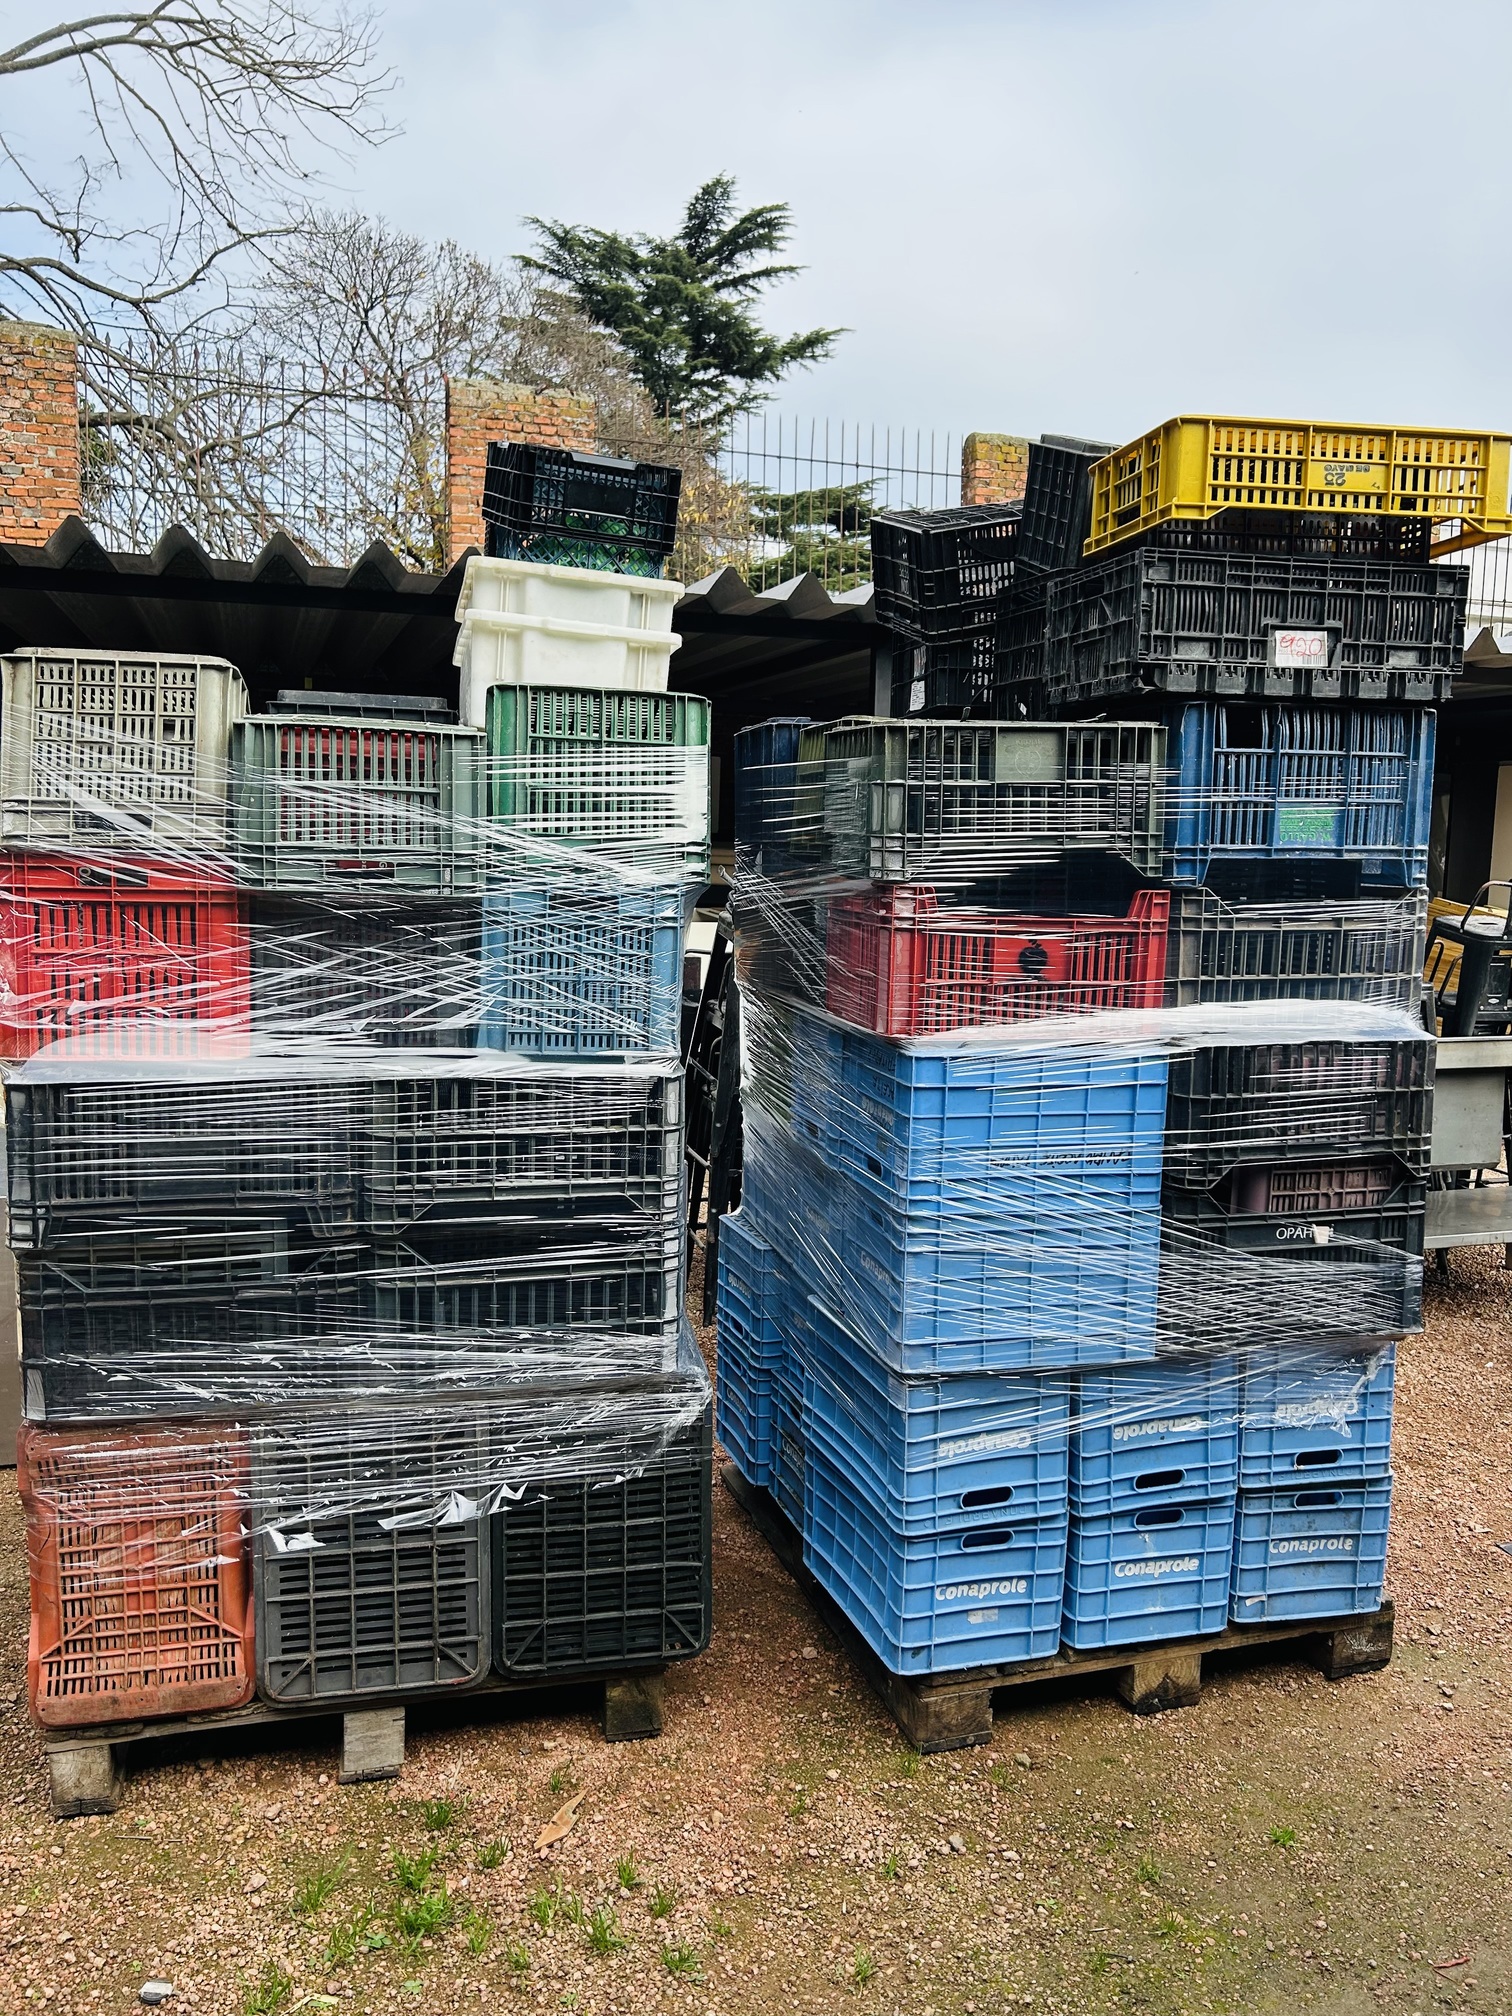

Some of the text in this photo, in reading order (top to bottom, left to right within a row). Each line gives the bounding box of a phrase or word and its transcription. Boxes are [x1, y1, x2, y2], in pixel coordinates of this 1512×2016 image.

[1324, 472, 1346, 487] 25
[1279, 633, 1322, 658] 920
[860, 1250, 891, 1286] Conapro
[1113, 1415, 1202, 1442] Conaprole
[938, 1431, 1031, 1459] Conaprole
[1269, 1536, 1353, 1556] Conaprole
[1114, 1556, 1199, 1578] Conaprole
[935, 1577, 1027, 1601] Conaprole
